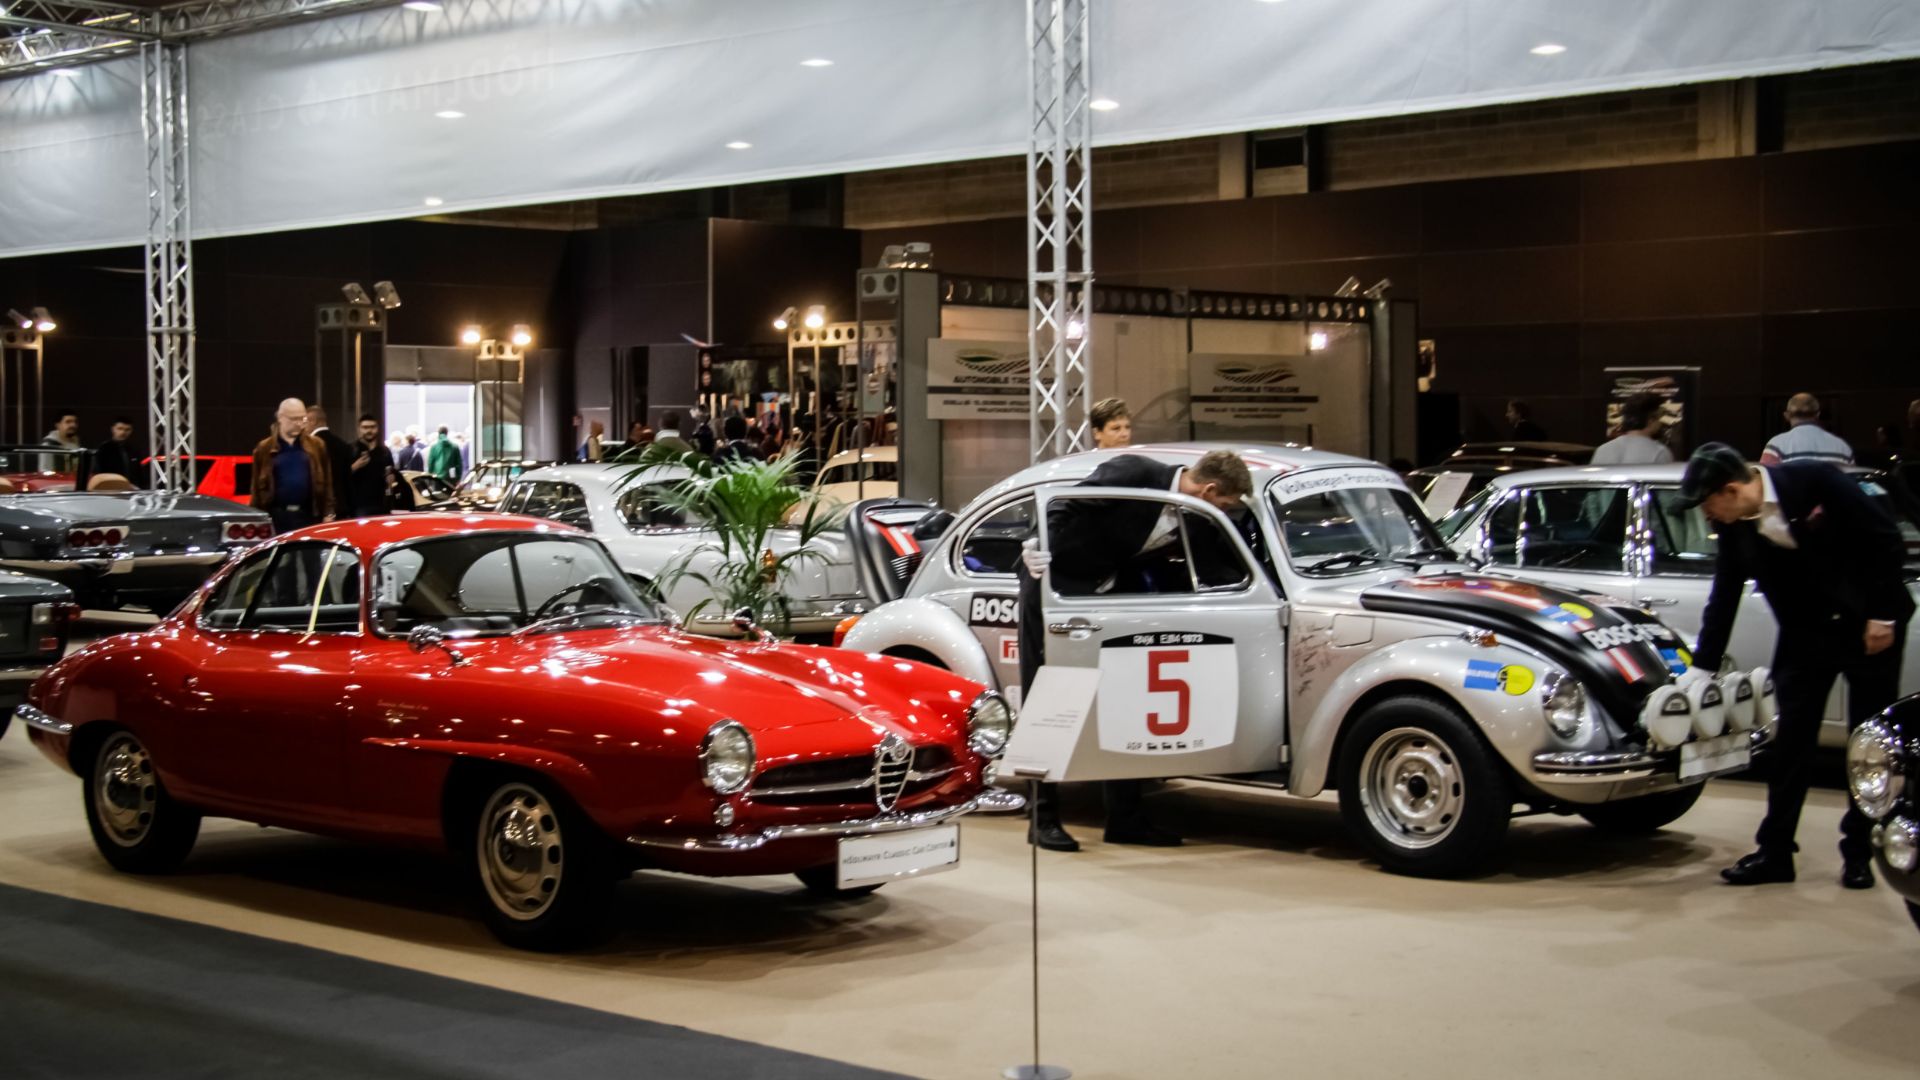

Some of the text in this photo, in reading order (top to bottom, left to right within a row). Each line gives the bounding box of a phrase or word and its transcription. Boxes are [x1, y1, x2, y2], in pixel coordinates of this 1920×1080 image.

[1279, 476, 1343, 495] Volkswagen
[970, 597, 1020, 623] BOS
[1146, 650, 1191, 737] 5
